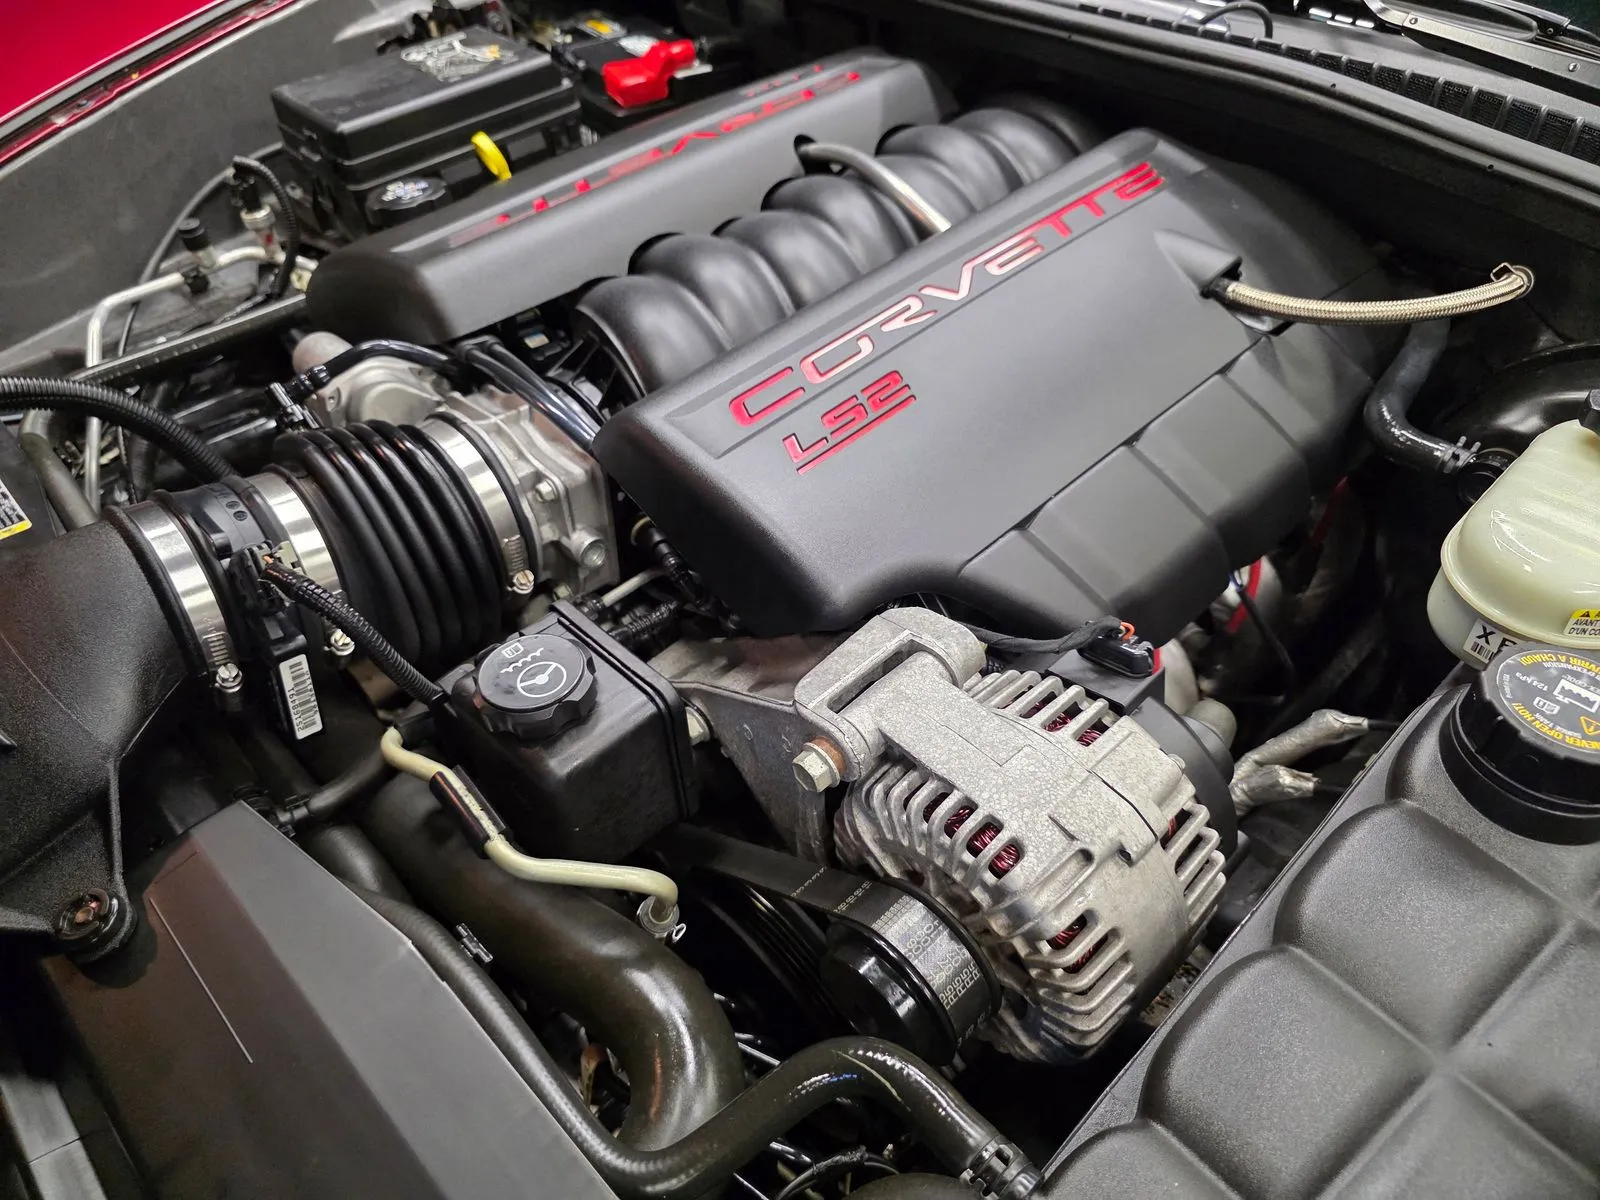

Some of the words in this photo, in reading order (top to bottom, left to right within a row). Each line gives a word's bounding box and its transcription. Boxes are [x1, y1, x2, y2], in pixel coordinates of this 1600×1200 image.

[728, 161, 1166, 427] CORVETTE
[782, 369, 912, 465] LS2
[1532, 680, 1549, 692] 124
[1511, 702, 1535, 722] HOT!
[1532, 719, 1564, 740] OPEN
